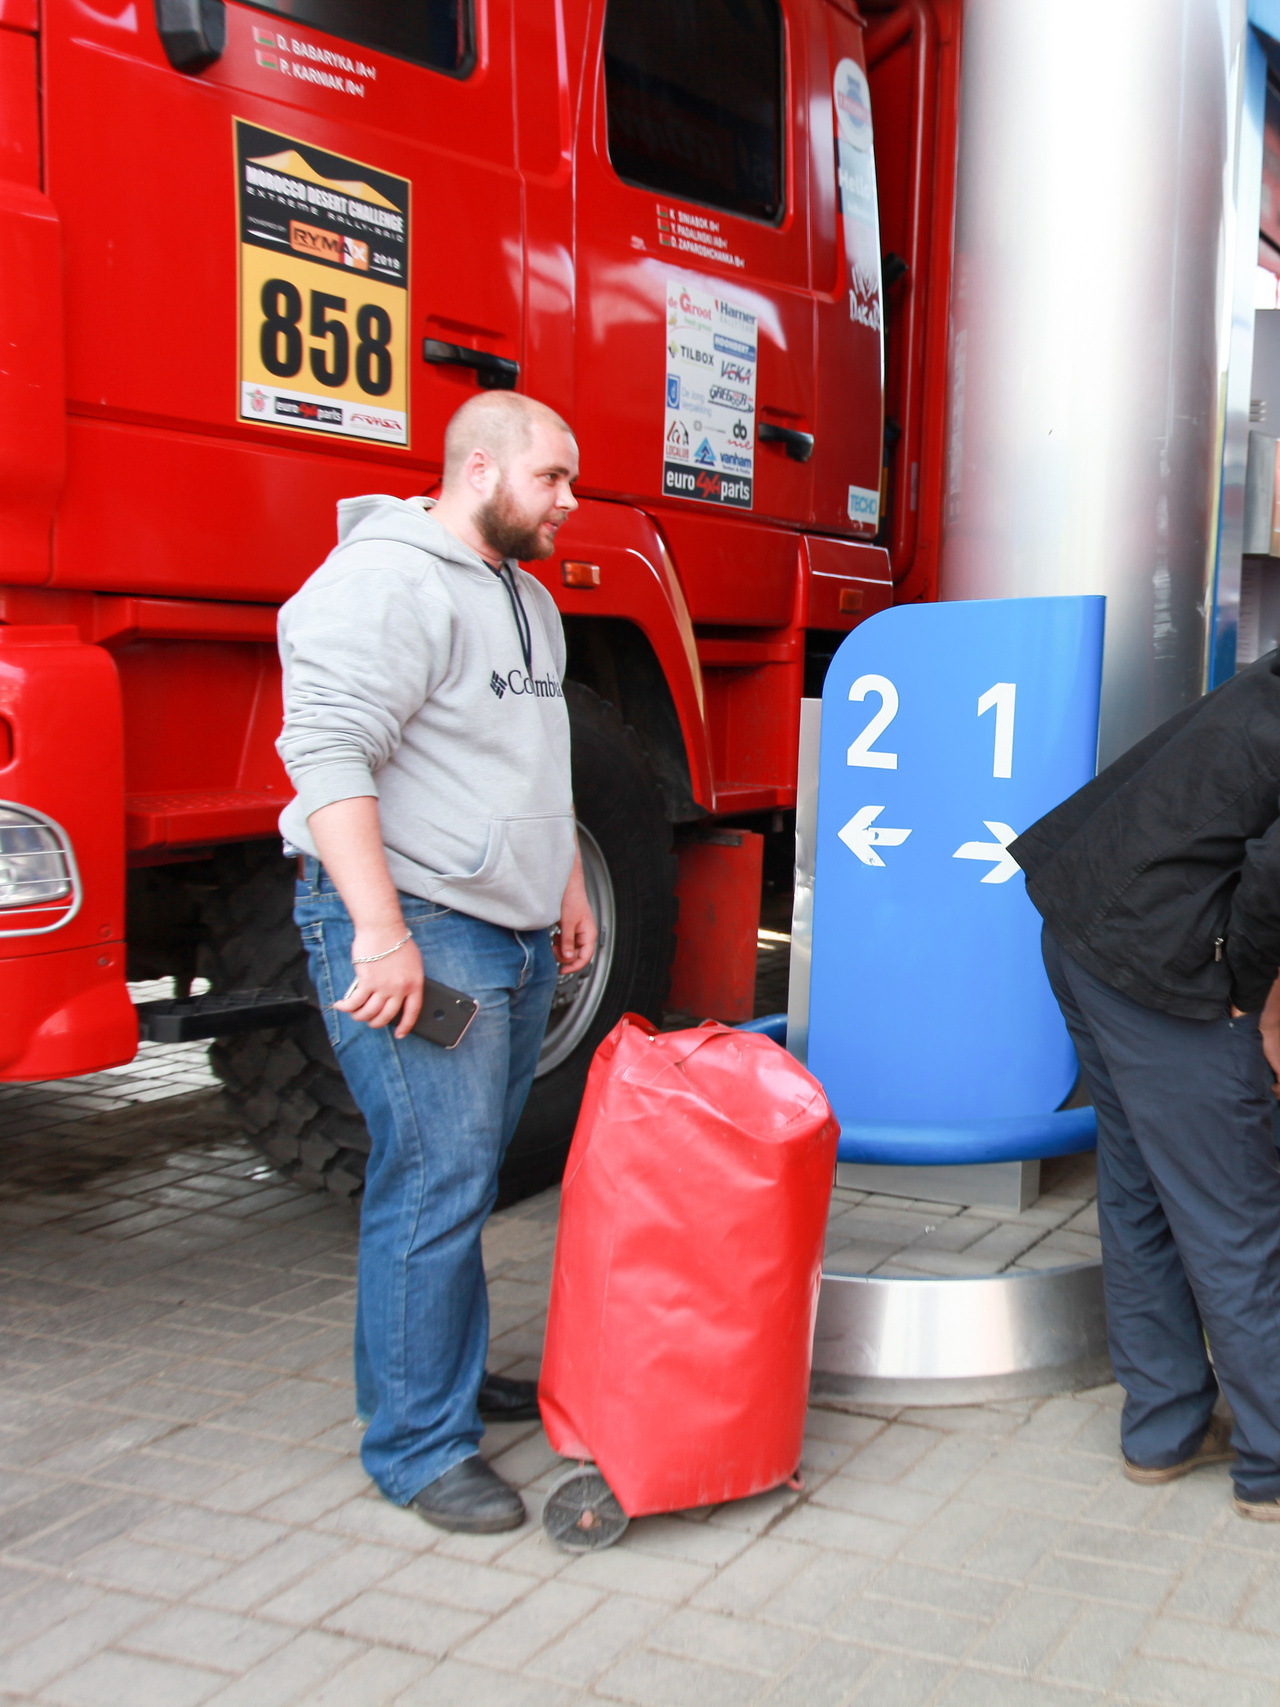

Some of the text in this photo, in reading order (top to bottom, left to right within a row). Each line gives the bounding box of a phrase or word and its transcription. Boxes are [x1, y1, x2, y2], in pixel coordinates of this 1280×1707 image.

[245, 164, 405, 234] MOROCCO DESERT CHALLENGE
[293, 227, 368, 263] RYMAX
[373, 252, 401, 270] 2019
[260, 277, 392, 397] 858
[681, 345, 715, 366] TILBOX
[721, 360, 753, 385] VEKA
[847, 674, 899, 770] 2
[977, 682, 1016, 778] 1
